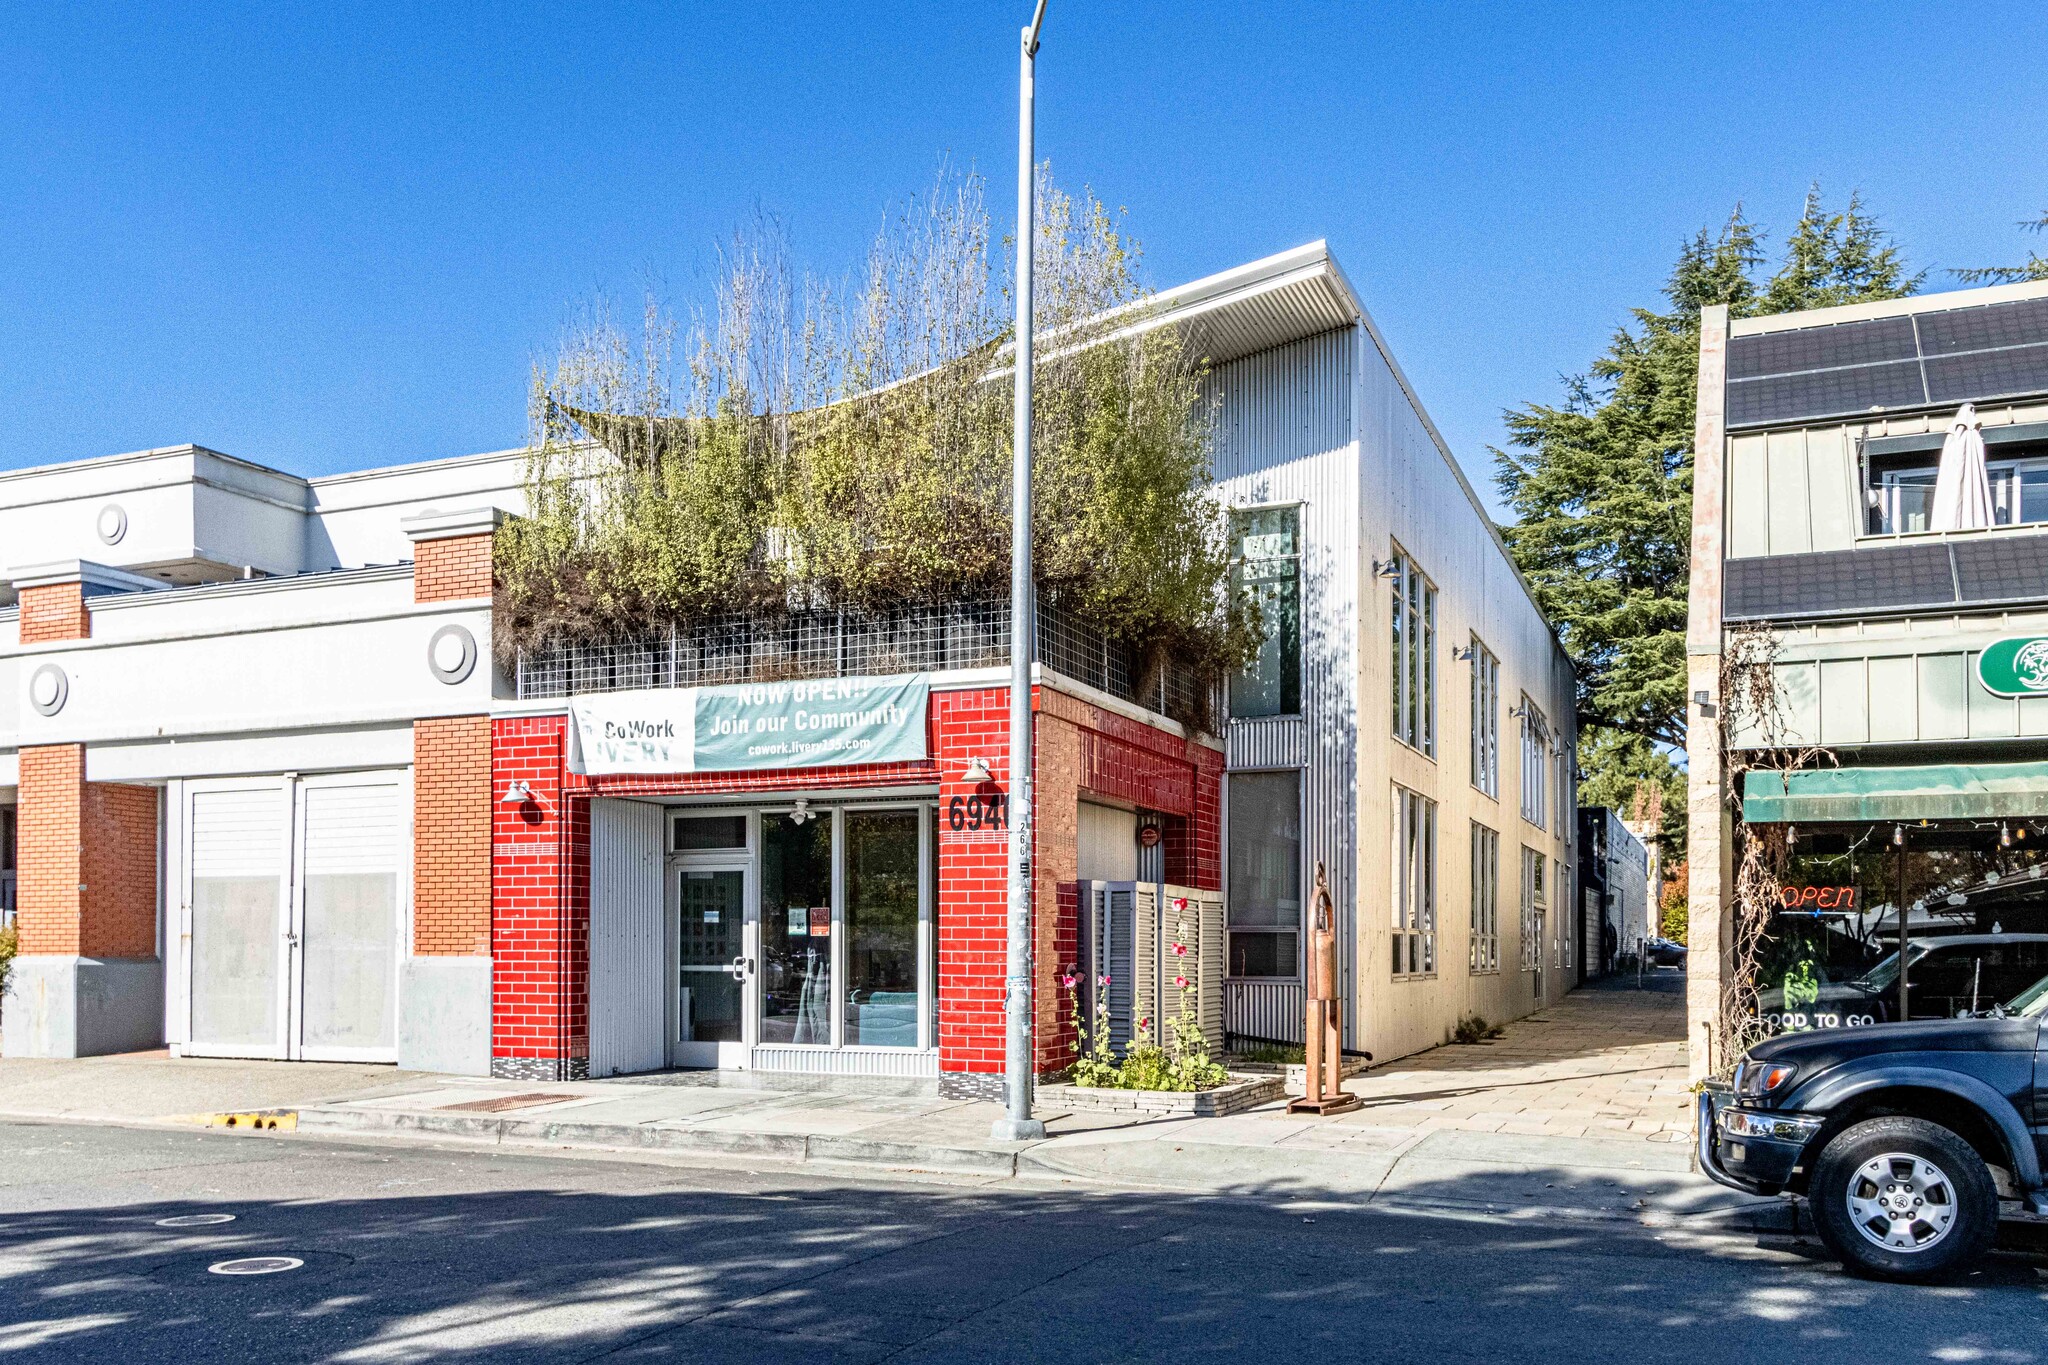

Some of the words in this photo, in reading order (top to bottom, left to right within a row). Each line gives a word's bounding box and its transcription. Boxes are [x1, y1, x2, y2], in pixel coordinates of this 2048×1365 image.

[737, 684, 786, 706] NOW
[793, 679, 869, 702] OPEN!!
[605, 719, 675, 739] CoWork
[710, 715, 749, 736] Join
[756, 716, 788, 732] our
[795, 704, 908, 730] Community
[584, 740, 673, 763] IVERY
[1780, 886, 1854, 908] OPEN
[1760, 1013, 1808, 1028] OOD
[1814, 1013, 1839, 1028] TO
[1846, 1014, 1874, 1028] GO
